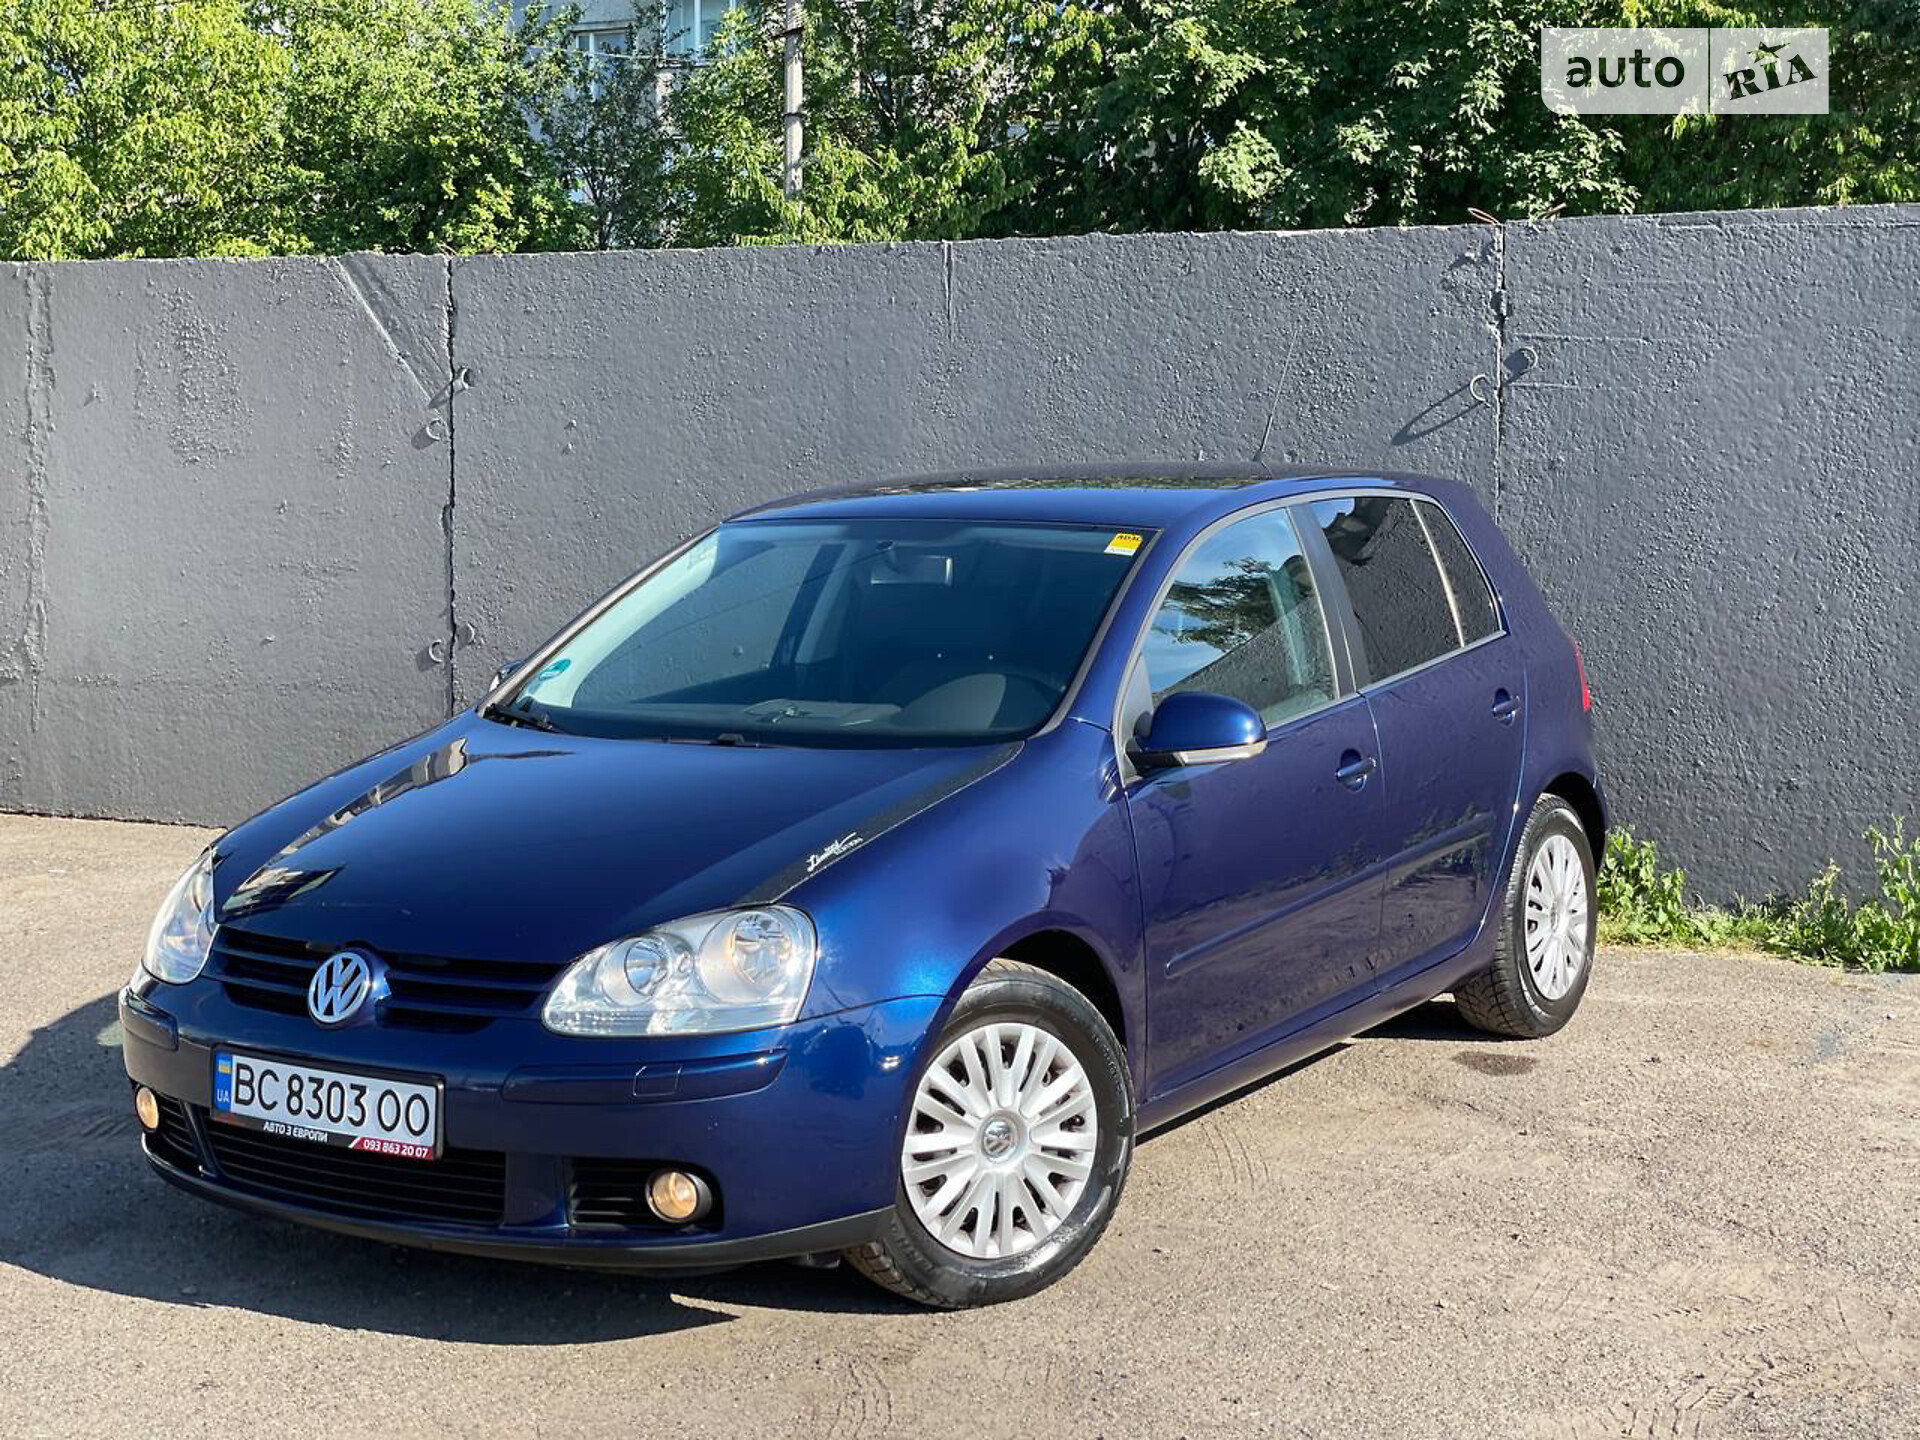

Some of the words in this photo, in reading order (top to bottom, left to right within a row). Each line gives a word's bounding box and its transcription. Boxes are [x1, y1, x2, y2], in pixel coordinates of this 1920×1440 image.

[216, 1089, 230, 1103] UA
[235, 1063, 280, 1111] BC
[286, 1073, 367, 1127] 8303
[363, 1139, 381, 1152] 093
[382, 1142, 400, 1155] 863
[401, 1145, 415, 1156] 20
[415, 1147, 429, 1159] 07
